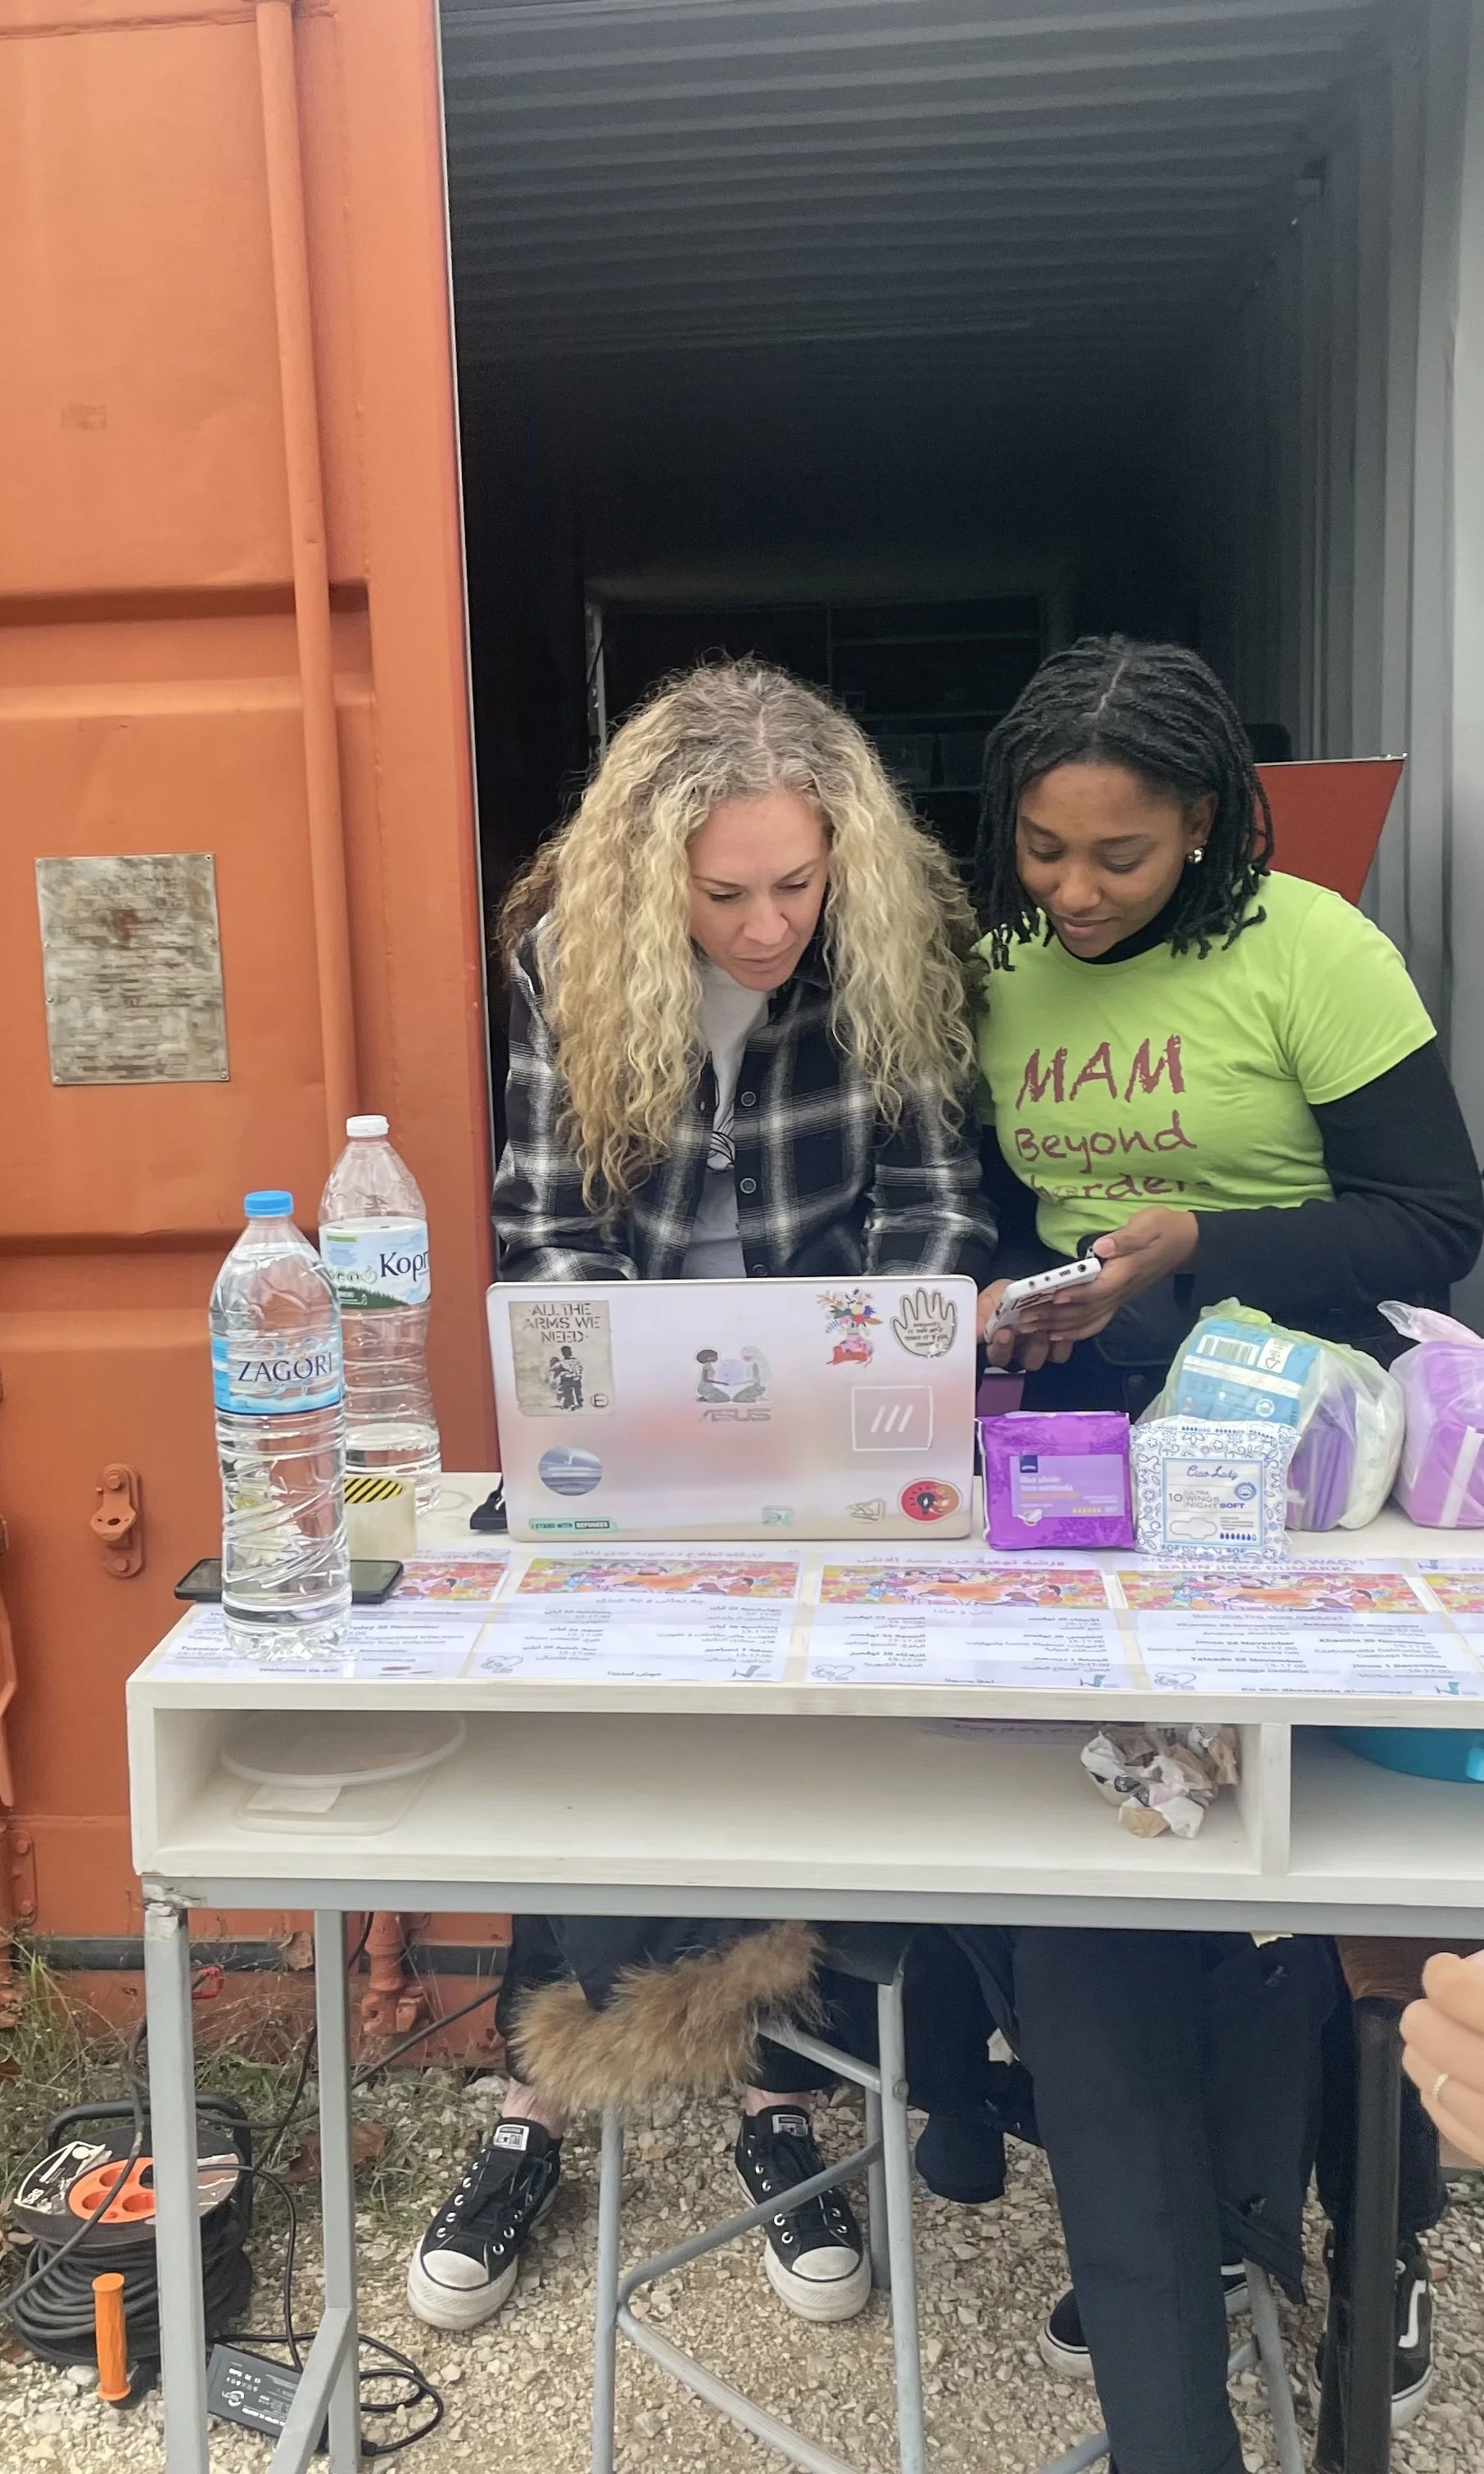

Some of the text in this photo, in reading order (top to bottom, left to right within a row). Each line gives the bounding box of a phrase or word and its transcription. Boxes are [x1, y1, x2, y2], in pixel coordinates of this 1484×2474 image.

[1015, 1034, 1186, 1111] MAM
[1015, 1109, 1197, 1174] Beyond
[532, 1303, 591, 1316] ALL THE
[524, 1316, 601, 1329] ARMS WE
[541, 1330, 584, 1343] NEED
[238, 1353, 333, 1382] ZAGORI
[1169, 1493, 1183, 1502] 10
